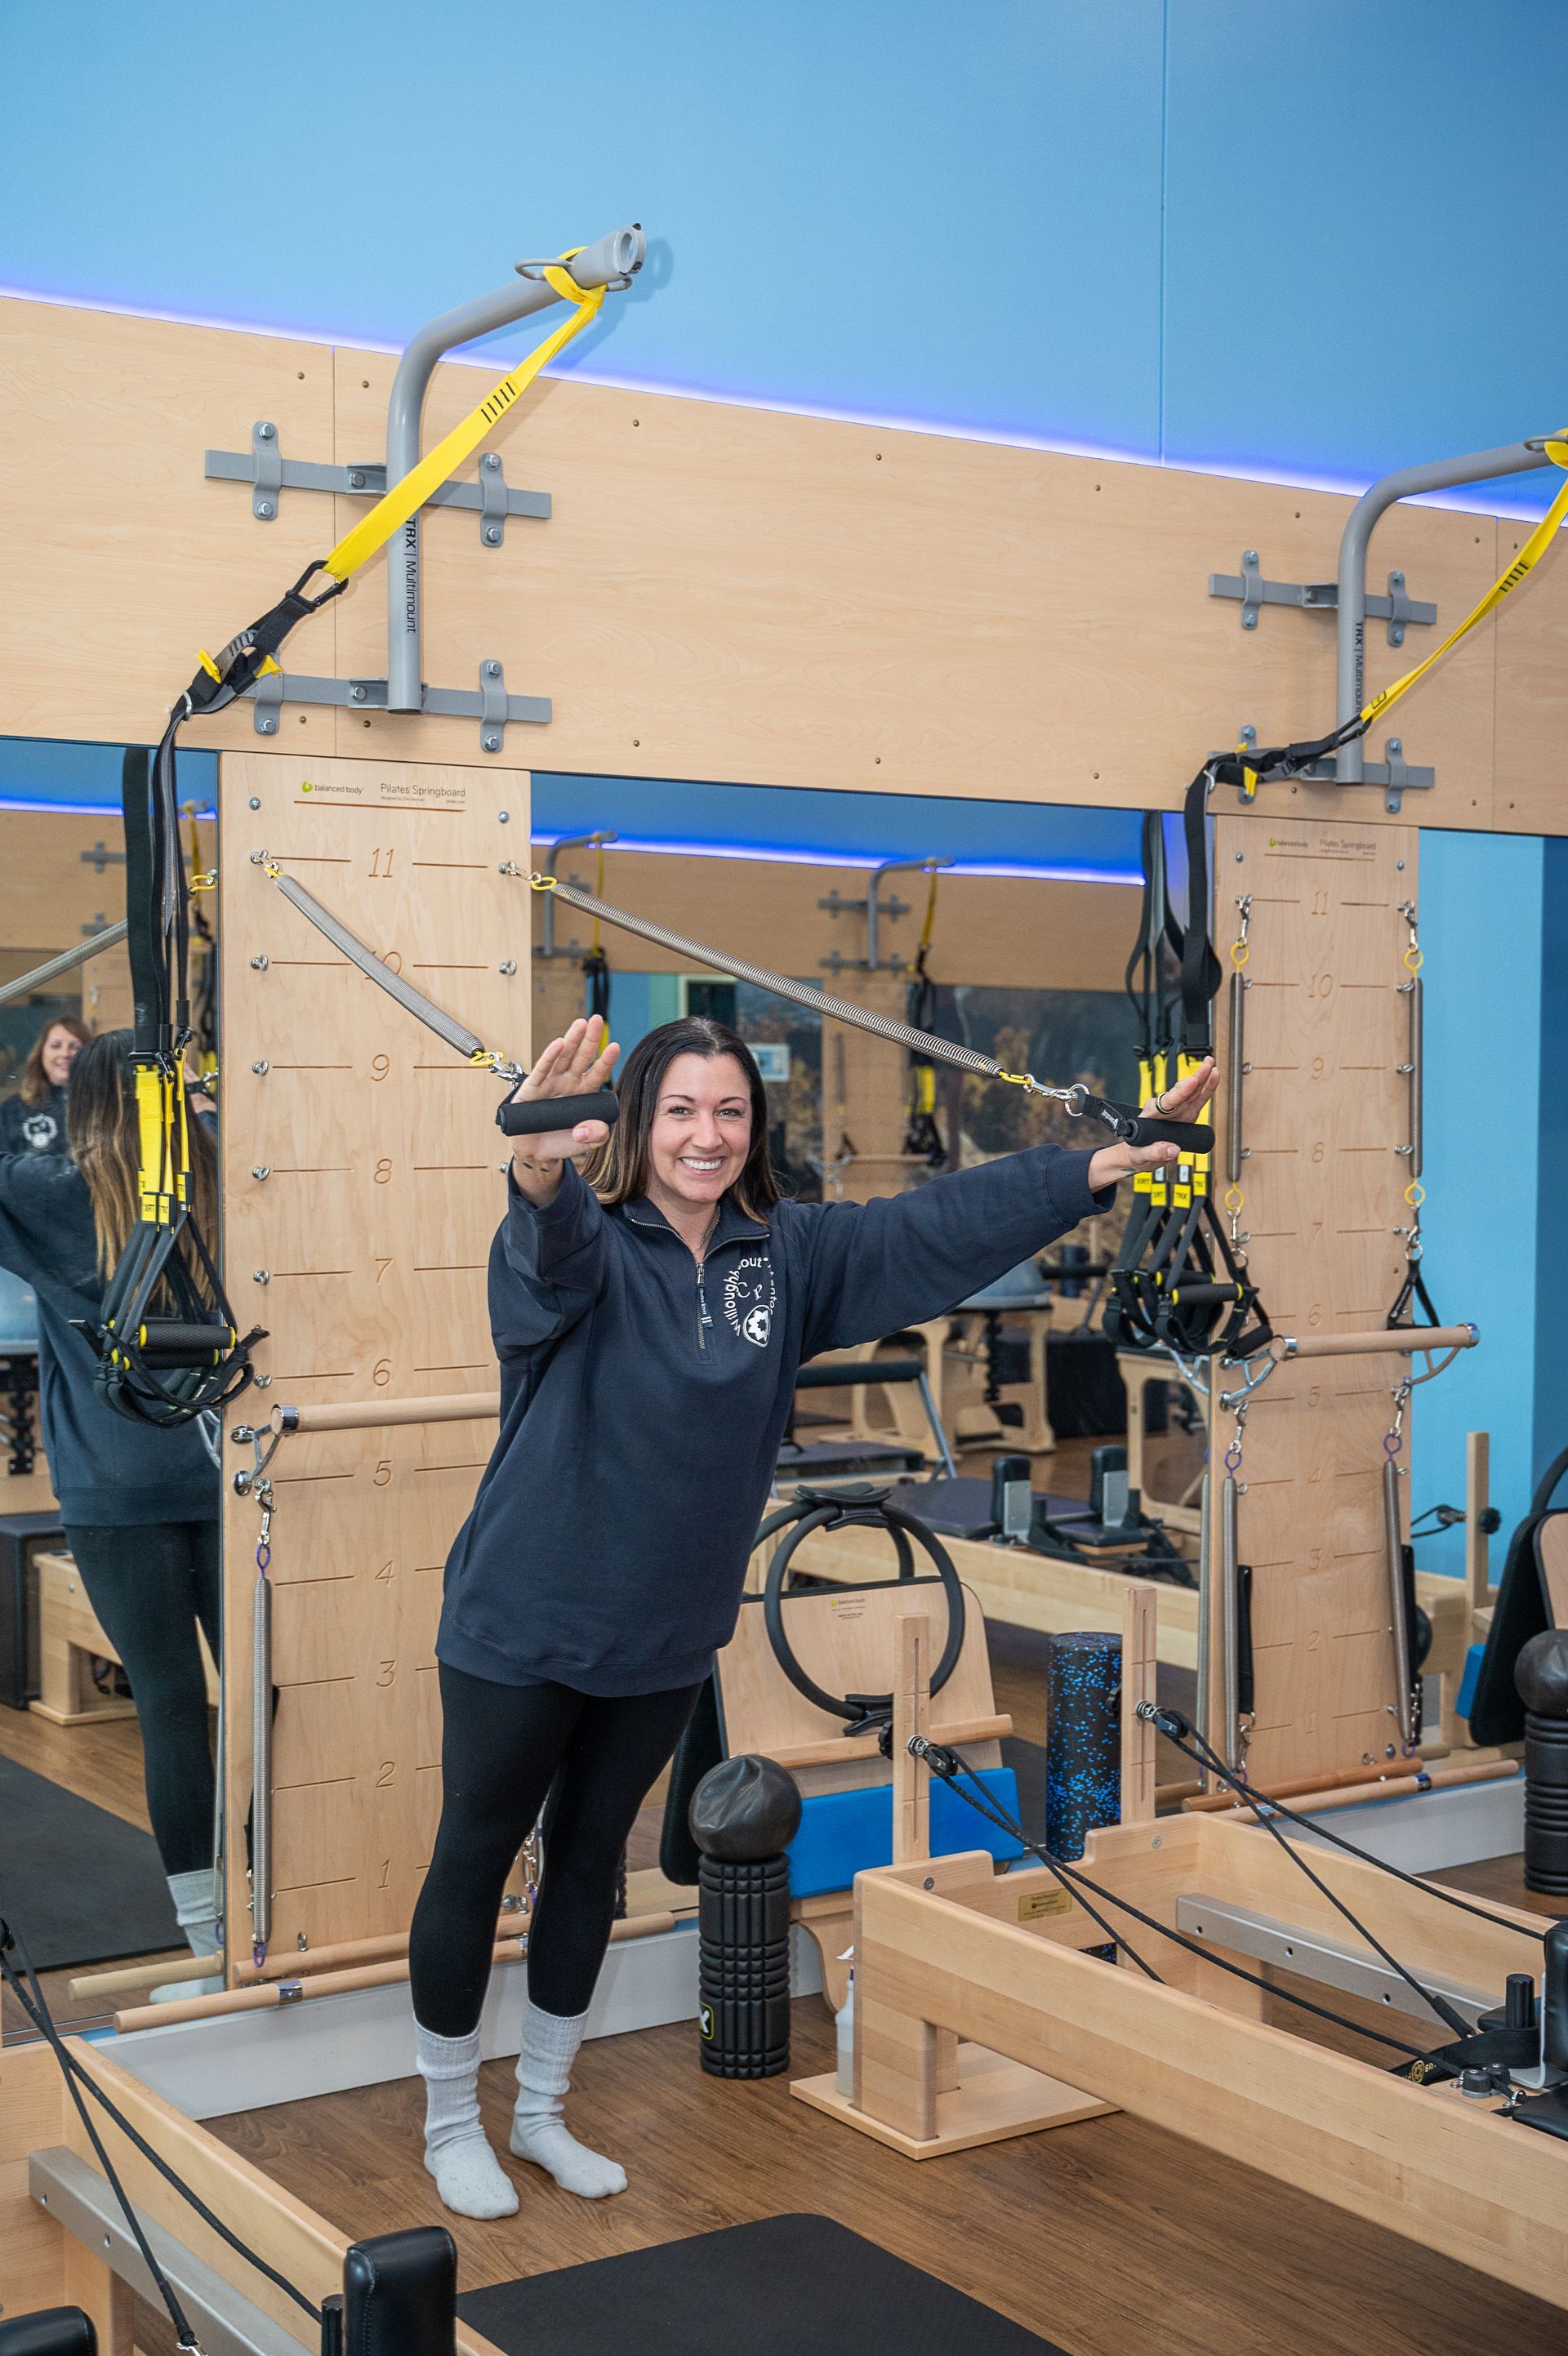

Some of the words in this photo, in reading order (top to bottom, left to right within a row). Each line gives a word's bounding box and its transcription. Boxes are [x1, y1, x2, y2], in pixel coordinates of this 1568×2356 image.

[405, 518, 417, 549] TRX
[406, 560, 417, 634] Multimount
[314, 784, 345, 794] balanced
[345, 786, 363, 795] body
[381, 783, 410, 795] Pilates
[412, 786, 466, 798] Springboard
[368, 848, 394, 878] 11
[1312, 891, 1330, 915] 11
[1307, 974, 1333, 998] 10
[372, 1054, 390, 1081] 9
[1311, 1057, 1325, 1080] 9
[1312, 1142, 1325, 1163] 8
[374, 1158, 392, 1185] 8
[1313, 1223, 1324, 1245] 7
[376, 1258, 394, 1284] 7
[1308, 1303, 1322, 1326] 6
[372, 1359, 391, 1386] 6
[1308, 1386, 1321, 1407] 5
[372, 1460, 392, 1486] 5
[1309, 1467, 1322, 1488] 4
[1308, 1549, 1321, 1570] 3
[374, 1560, 394, 1586] 4
[1307, 1631, 1321, 1651] 2
[376, 1660, 397, 1687] 3
[1307, 1712, 1315, 1732] 1
[376, 1761, 395, 1788] 2
[379, 1859, 390, 1888] 1
